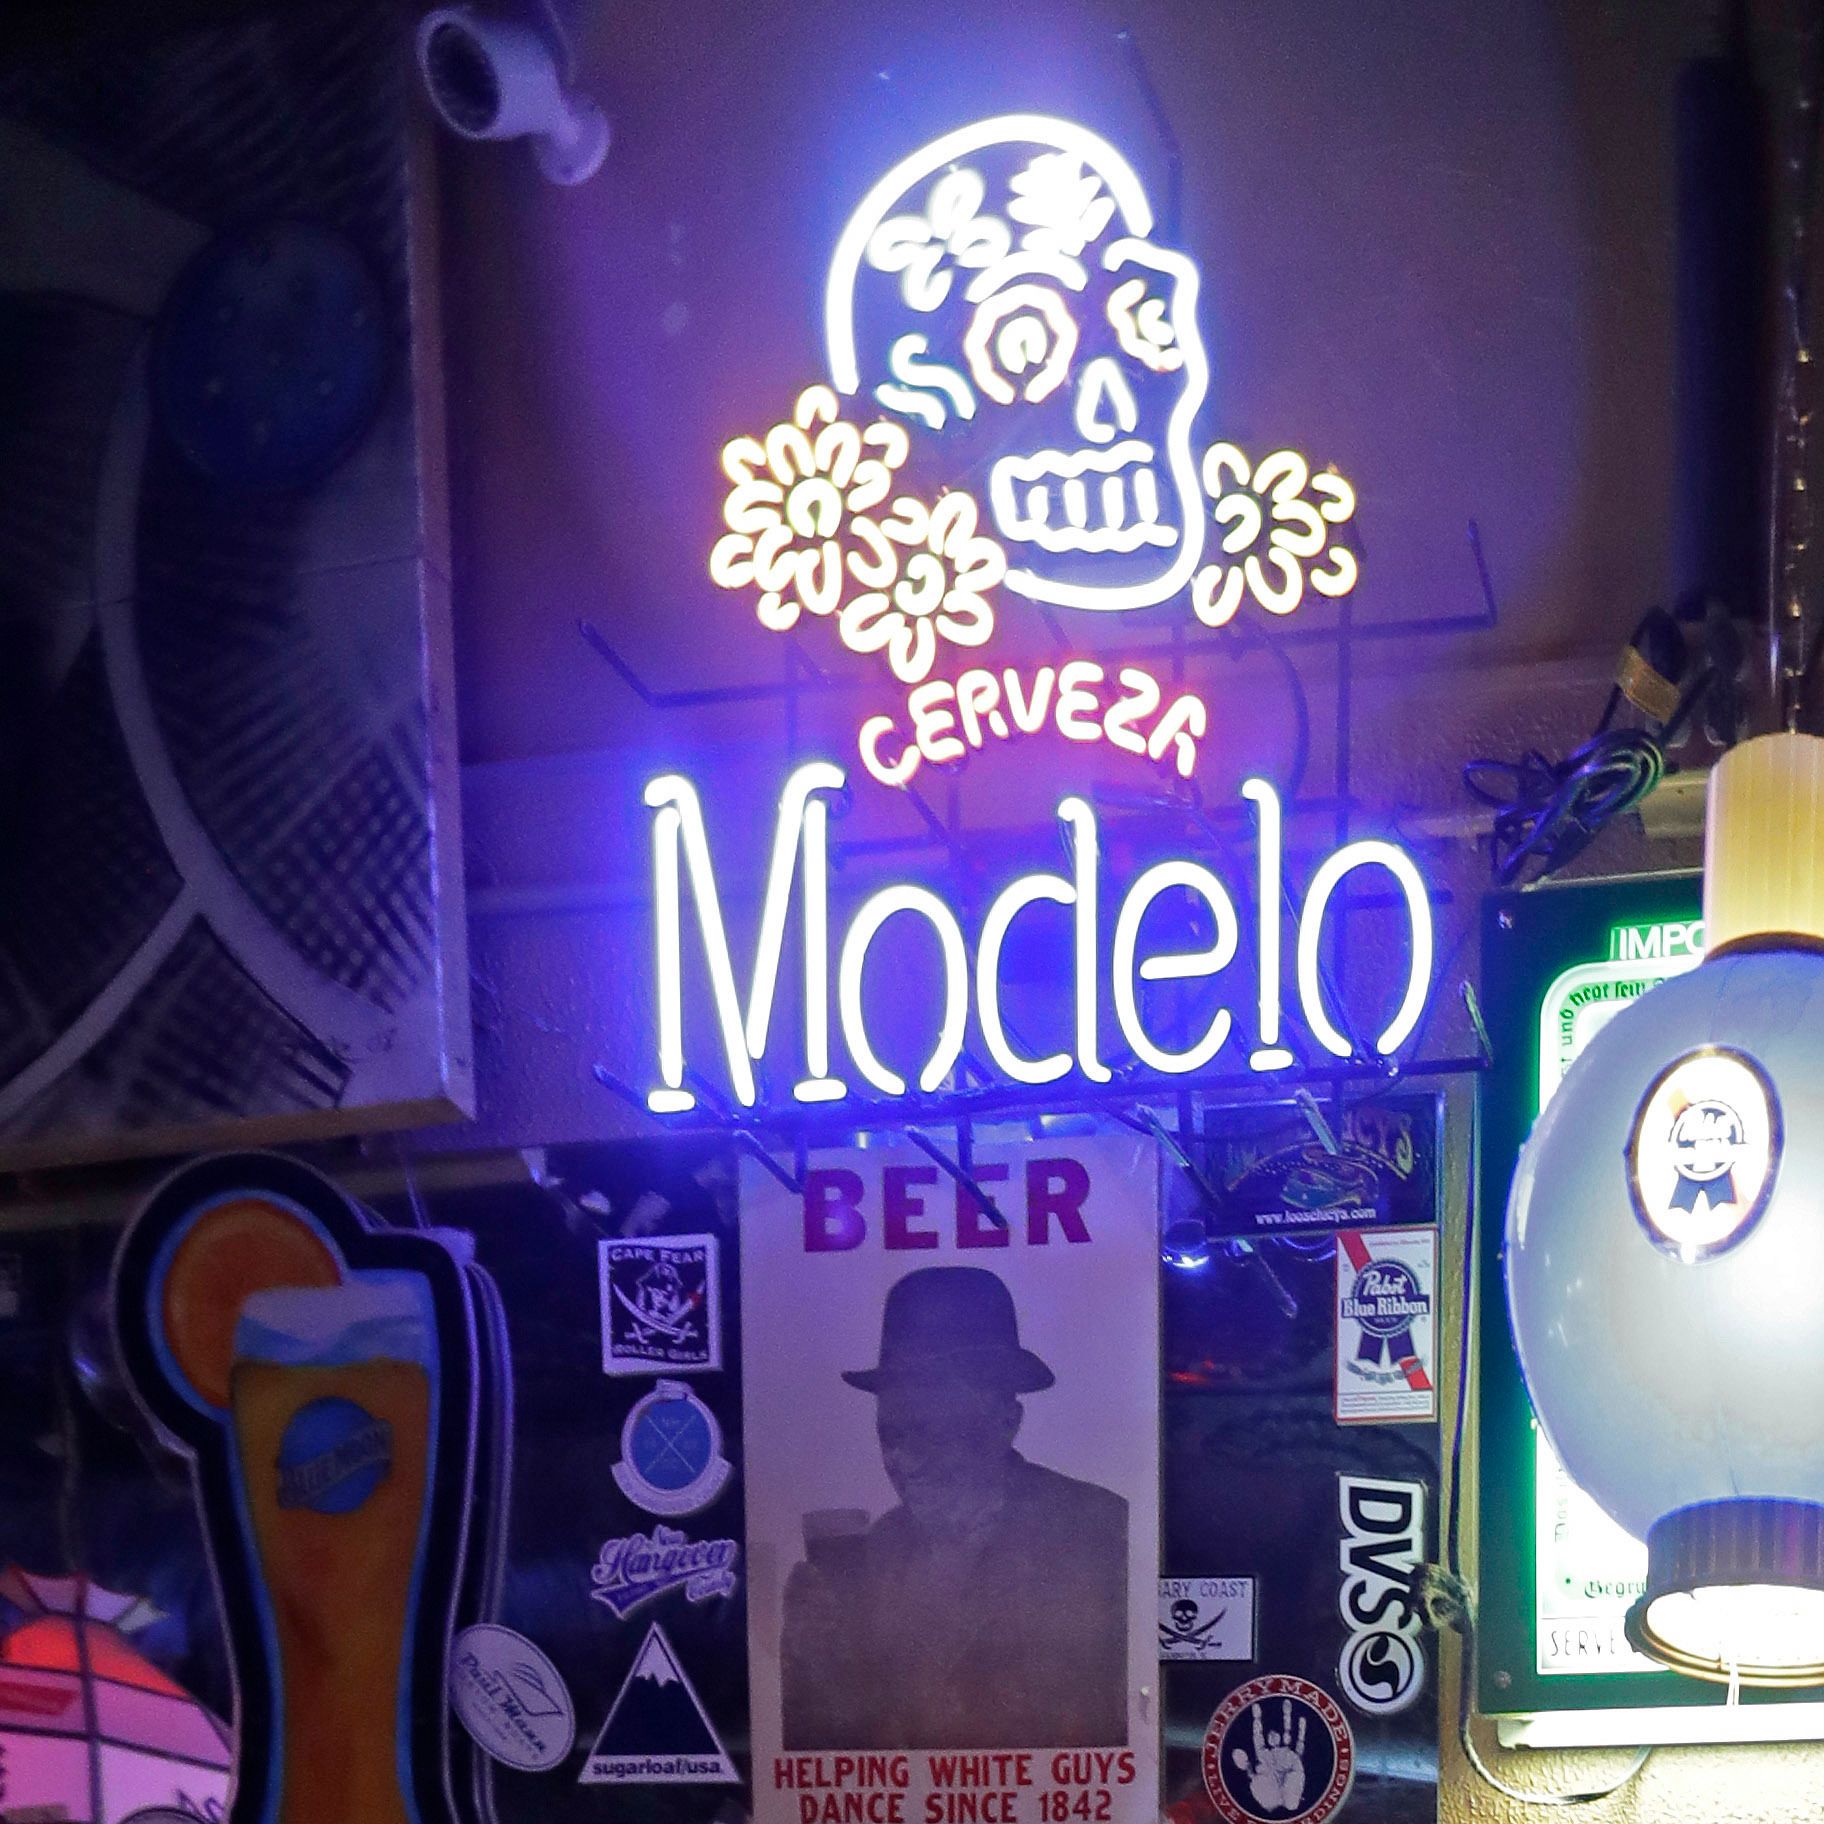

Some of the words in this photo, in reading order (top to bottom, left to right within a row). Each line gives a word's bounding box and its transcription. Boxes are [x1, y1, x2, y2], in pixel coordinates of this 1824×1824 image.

[859, 660, 1206, 786] CERVEZA
[644, 762, 1433, 1112] Modelo
[1619, 920, 1705, 961] IMPO
[802, 1156, 1093, 1253] BEER
[610, 1247, 655, 1262] CAPE
[659, 1249, 706, 1264] FEAR
[1362, 1270, 1408, 1297] Pabst
[1343, 1297, 1376, 1318] Blue
[1376, 1295, 1428, 1316] Ribbon
[1348, 1487, 1415, 1635] DVS
[1201, 1580, 1249, 1598] COAST
[593, 1757, 722, 1778] sugarloaf/usa
[773, 1754, 910, 1790] HELPING
[929, 1753, 1032, 1788] WHITE
[1051, 1752, 1137, 1785] GUYS
[925, 1792, 1018, 1824] SINCE
[1039, 1789, 1113, 1822] 1842
[1207, 1774, 1241, 1821] LIVE
